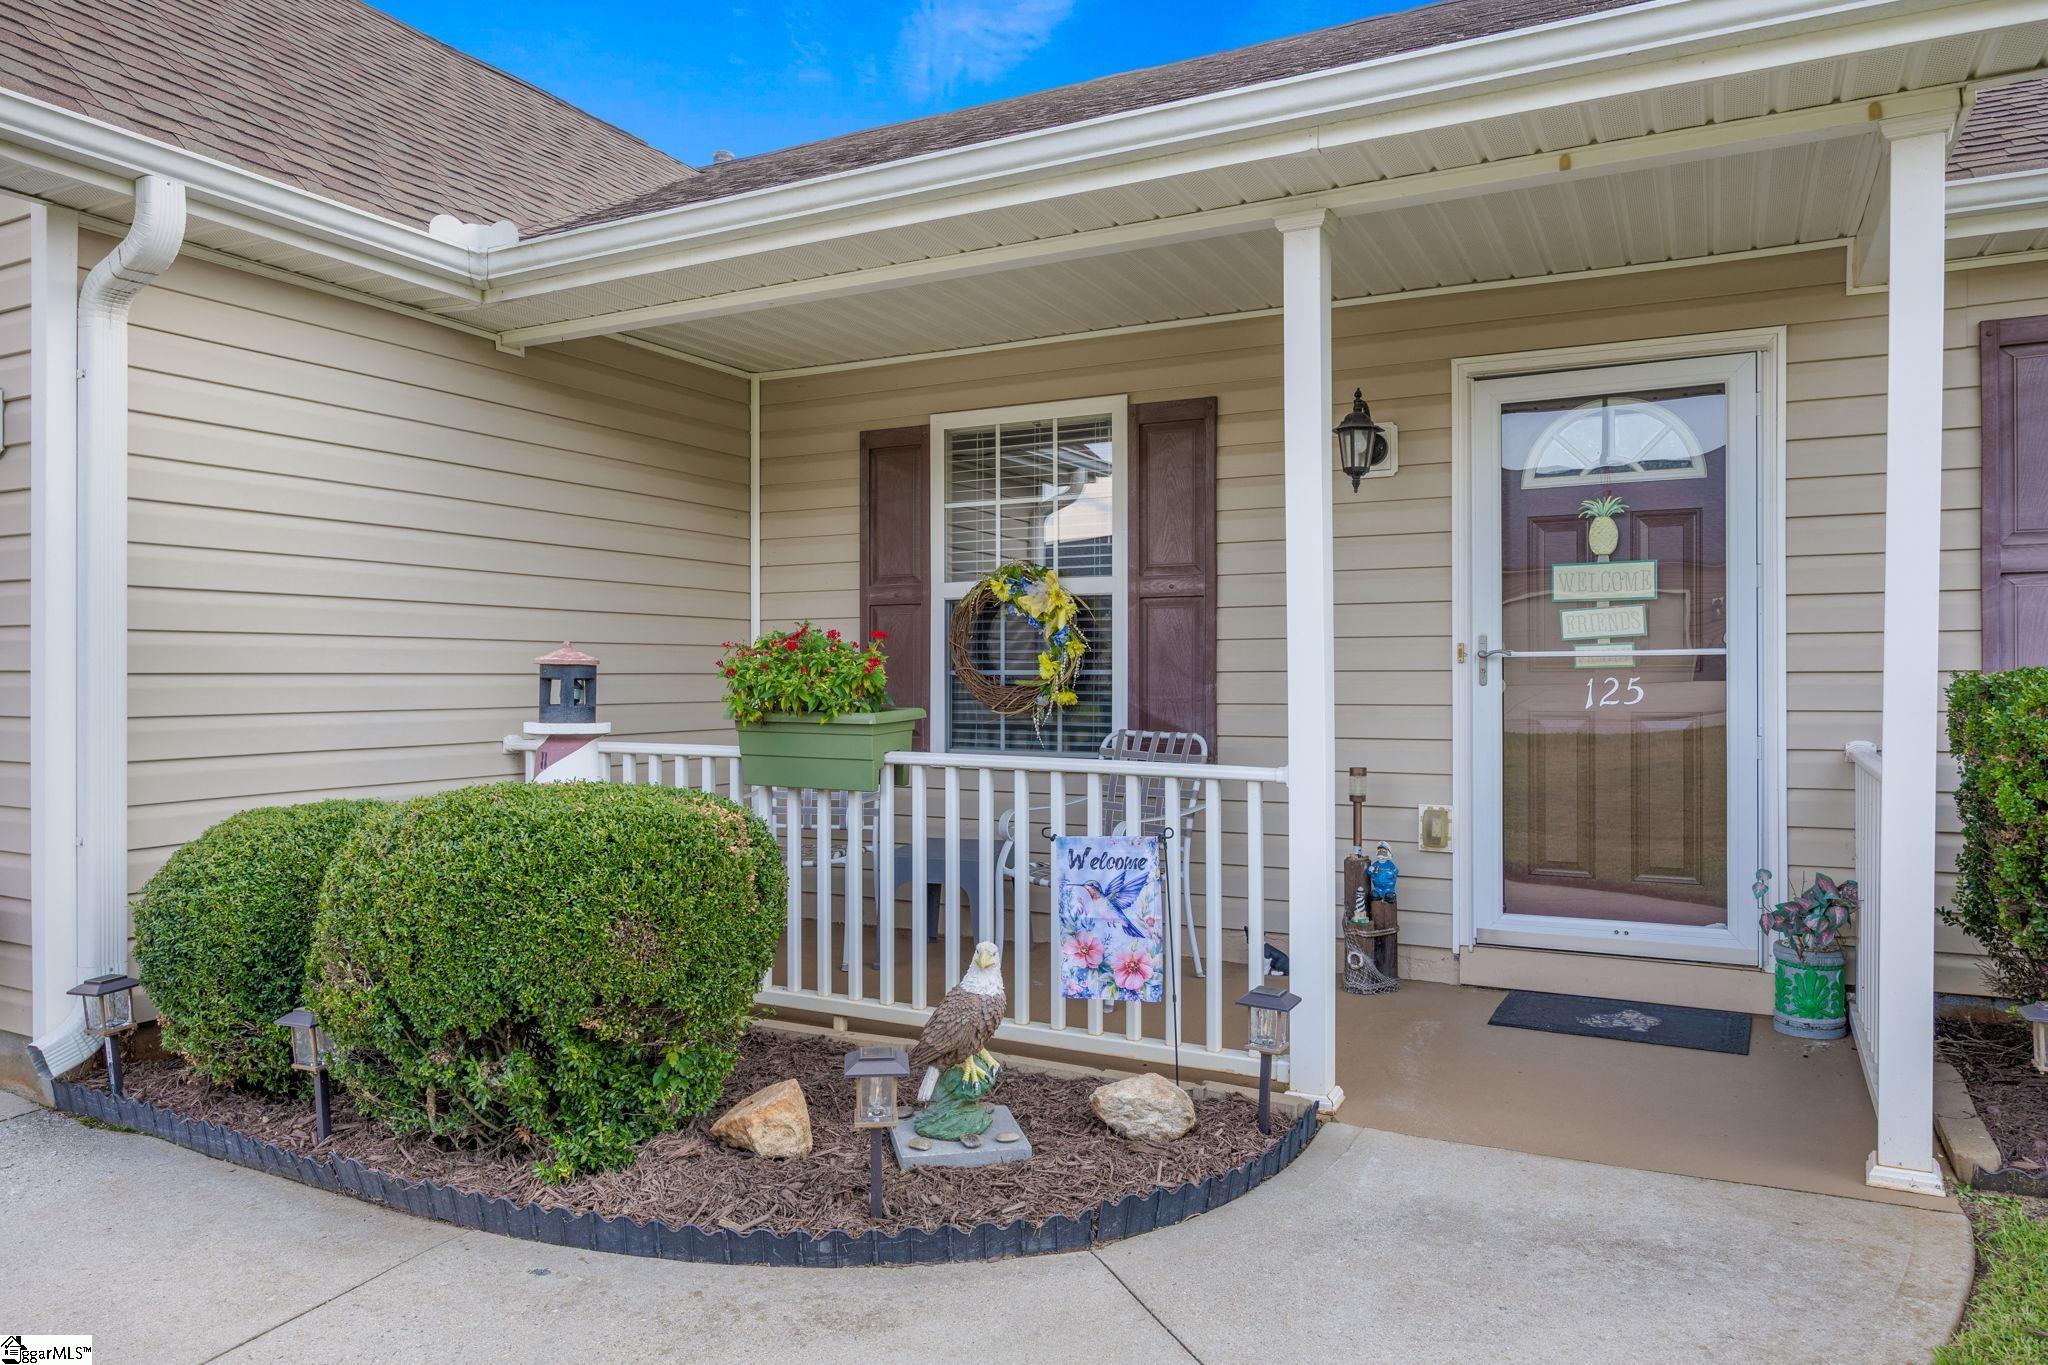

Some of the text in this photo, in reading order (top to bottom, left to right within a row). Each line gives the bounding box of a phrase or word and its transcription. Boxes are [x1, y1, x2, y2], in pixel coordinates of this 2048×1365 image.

[1558, 569, 1652, 593] WELCOME
[1566, 611, 1641, 634] FRIENDS
[1584, 675, 1645, 710] 125
[1067, 846, 1149, 872] Welcome
